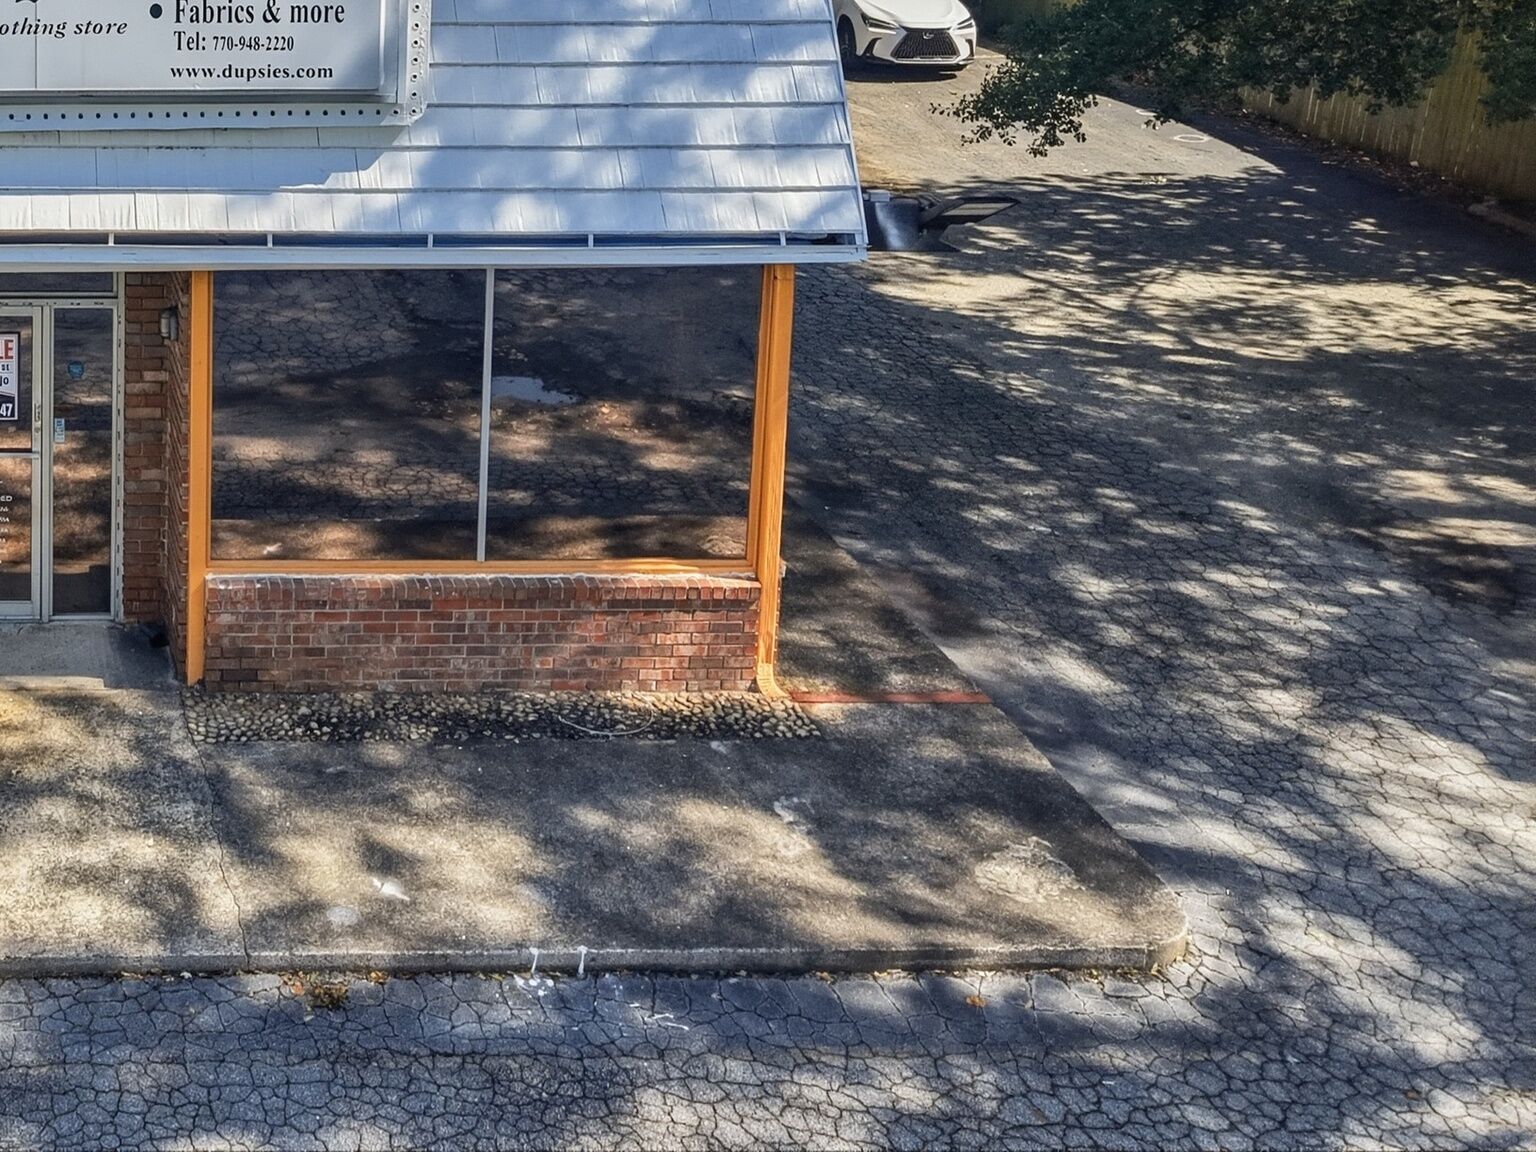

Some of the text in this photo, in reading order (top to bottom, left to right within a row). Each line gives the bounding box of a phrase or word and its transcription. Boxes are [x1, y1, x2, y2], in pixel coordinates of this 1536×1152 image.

[290, 4, 345, 23] more
[73, 20, 128, 35] store
[174, 31, 294, 51] Tel: 770-948-2220
[170, 64, 333, 82] www.dupsies.com
